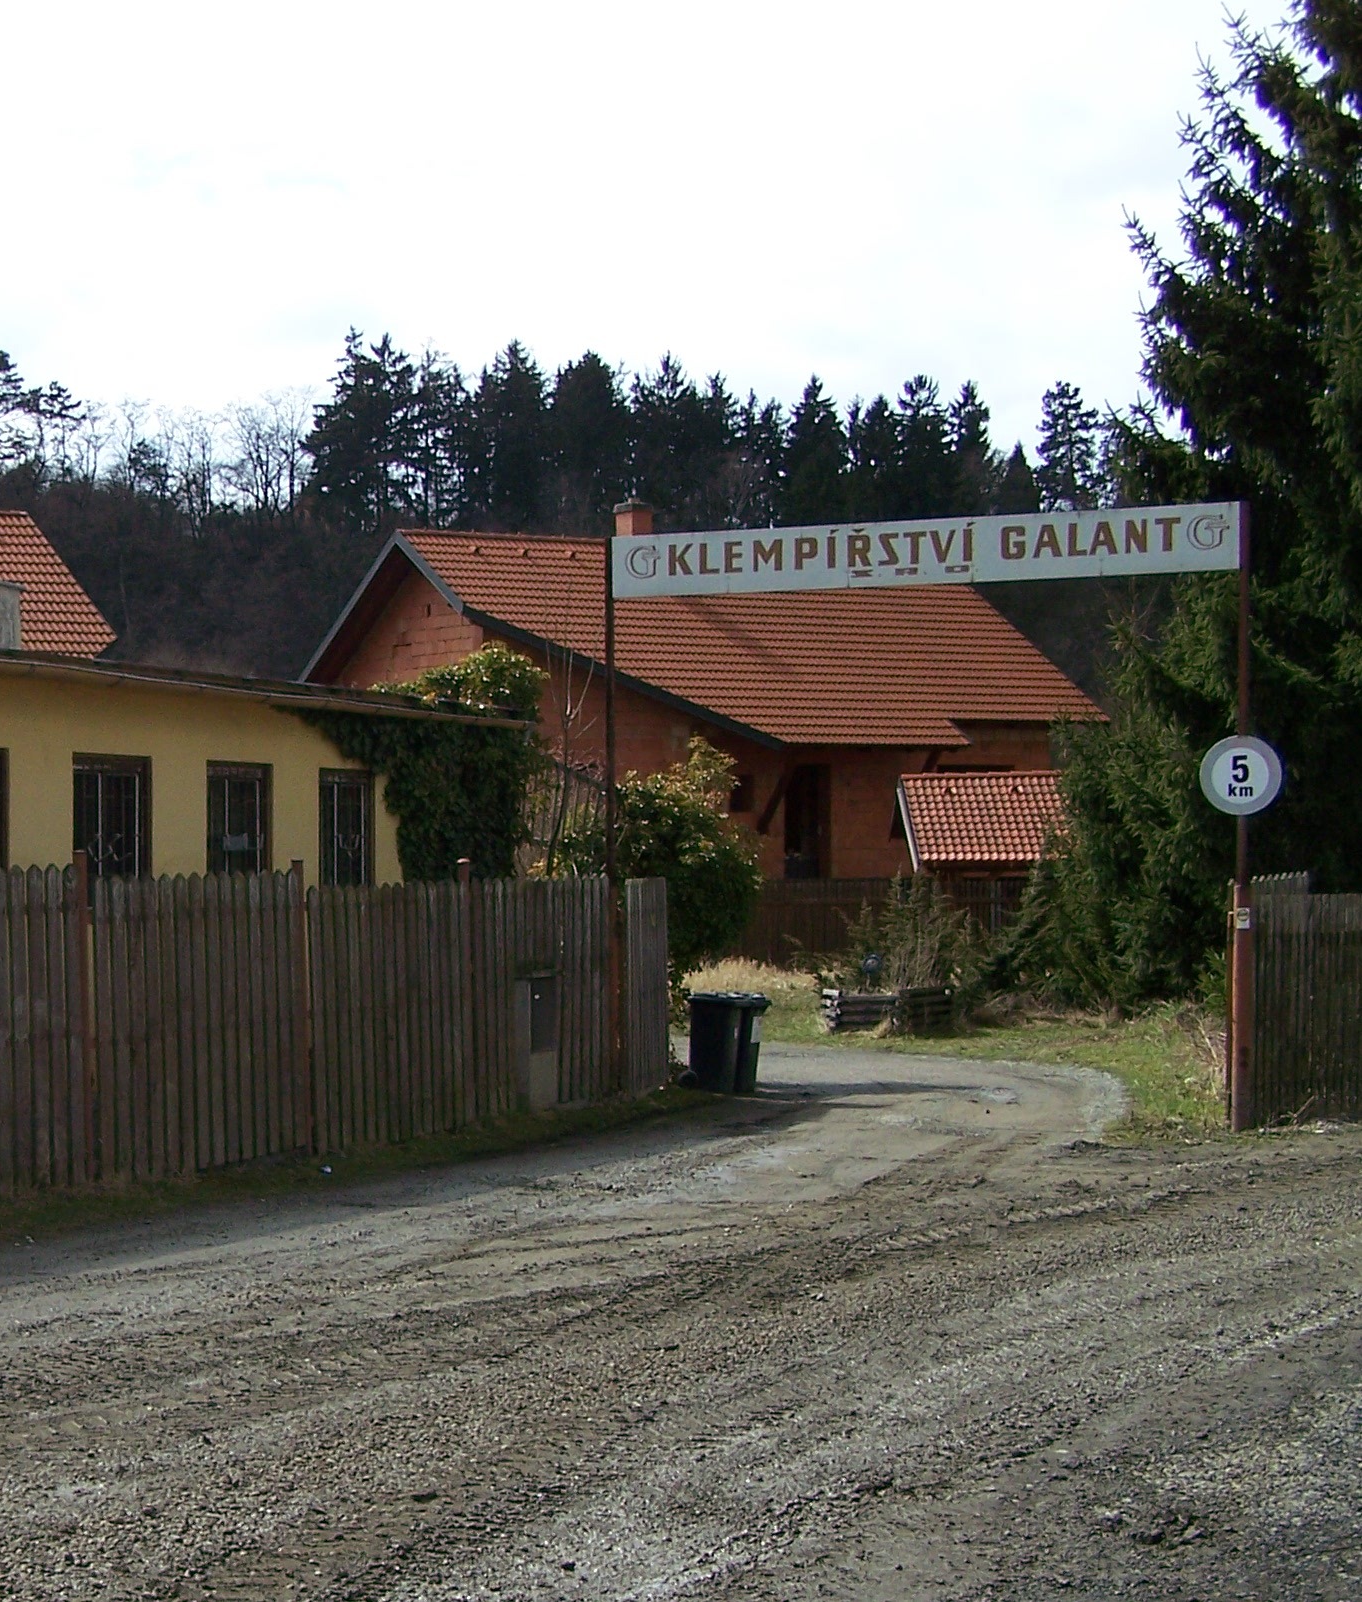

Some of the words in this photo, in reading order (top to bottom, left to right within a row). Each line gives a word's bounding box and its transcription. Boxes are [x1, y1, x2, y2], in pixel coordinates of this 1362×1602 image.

[668, 522, 976, 576] KLEMPÍŘSTVÍ
[1001, 517, 1181, 560] GALANT
[1232, 755, 1249, 783] 5
[1228, 783, 1253, 797] km
